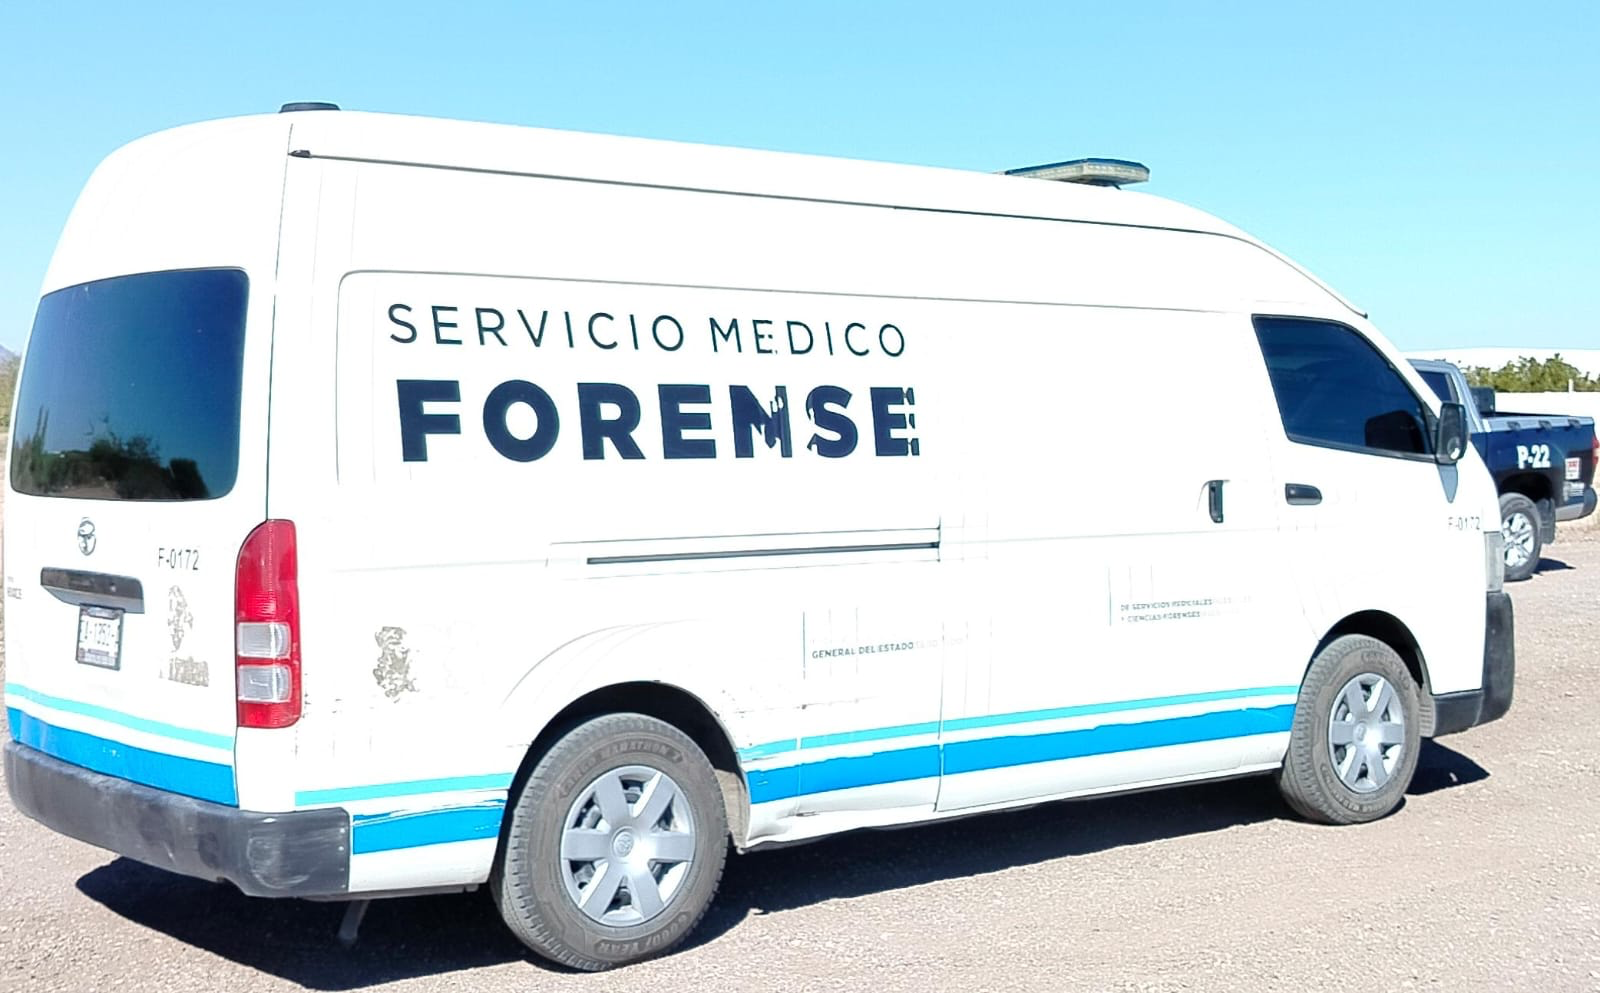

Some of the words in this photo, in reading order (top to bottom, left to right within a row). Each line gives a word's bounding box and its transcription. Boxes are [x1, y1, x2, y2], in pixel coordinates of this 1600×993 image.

[388, 303, 684, 353] SERVICIO
[709, 316, 905, 358] MEDICO
[395, 379, 920, 463] FORENSE
[1516, 445, 1552, 470] P-22
[158, 547, 200, 571] F-0172
[1127, 614, 1161, 623] CIENCIAS
[811, 647, 856, 659] GENERAL
[858, 645, 876, 655] DEL
[878, 641, 914, 653] ESTADO
